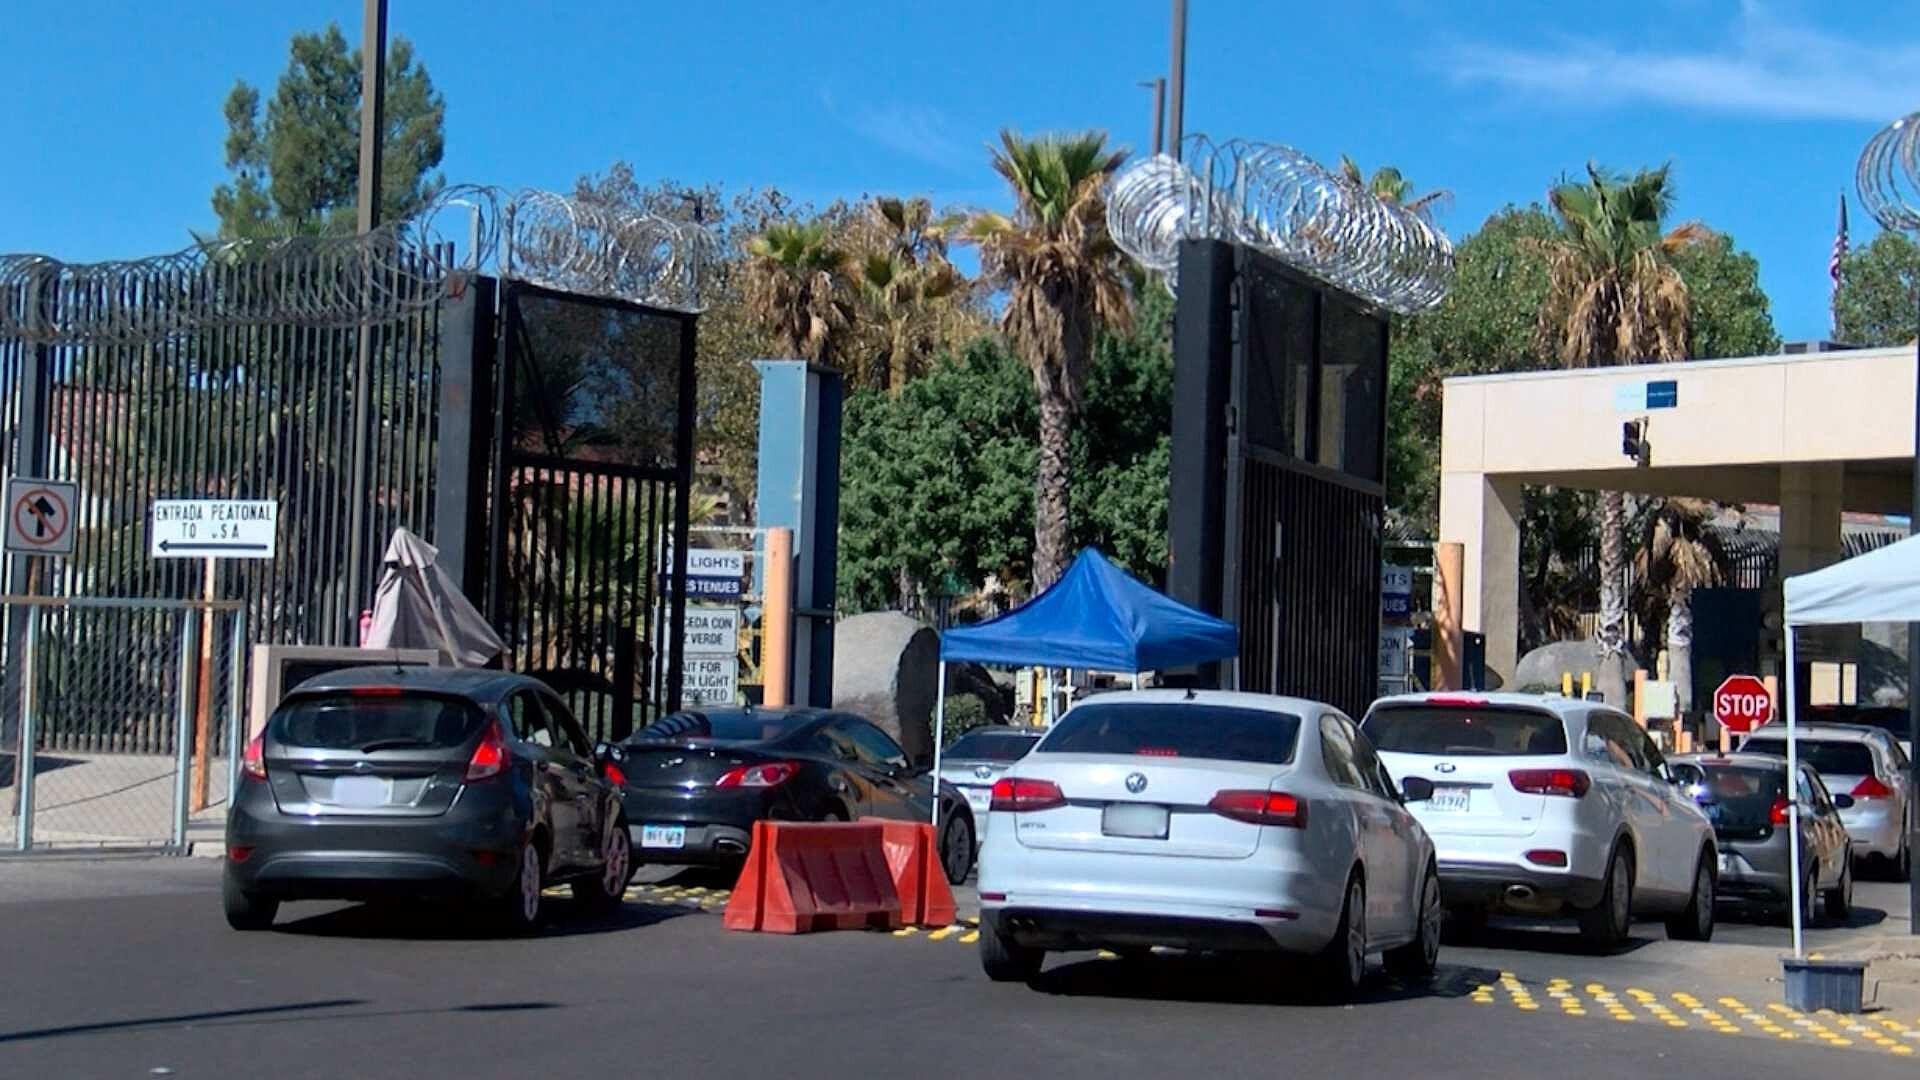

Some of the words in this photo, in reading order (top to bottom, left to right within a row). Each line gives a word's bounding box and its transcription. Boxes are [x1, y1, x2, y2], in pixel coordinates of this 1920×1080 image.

[156, 504, 203, 520] ENTRADA
[211, 503, 272, 520] PEATONAL
[181, 522, 197, 538] TO
[211, 523, 240, 538] SA
[690, 556, 740, 569] LIGHTS
[711, 616, 733, 629] CON
[690, 632, 723, 645] VERDE
[699, 662, 721, 673] FOR
[698, 674, 729, 687] LIGHT
[1718, 693, 1768, 717] STOP
